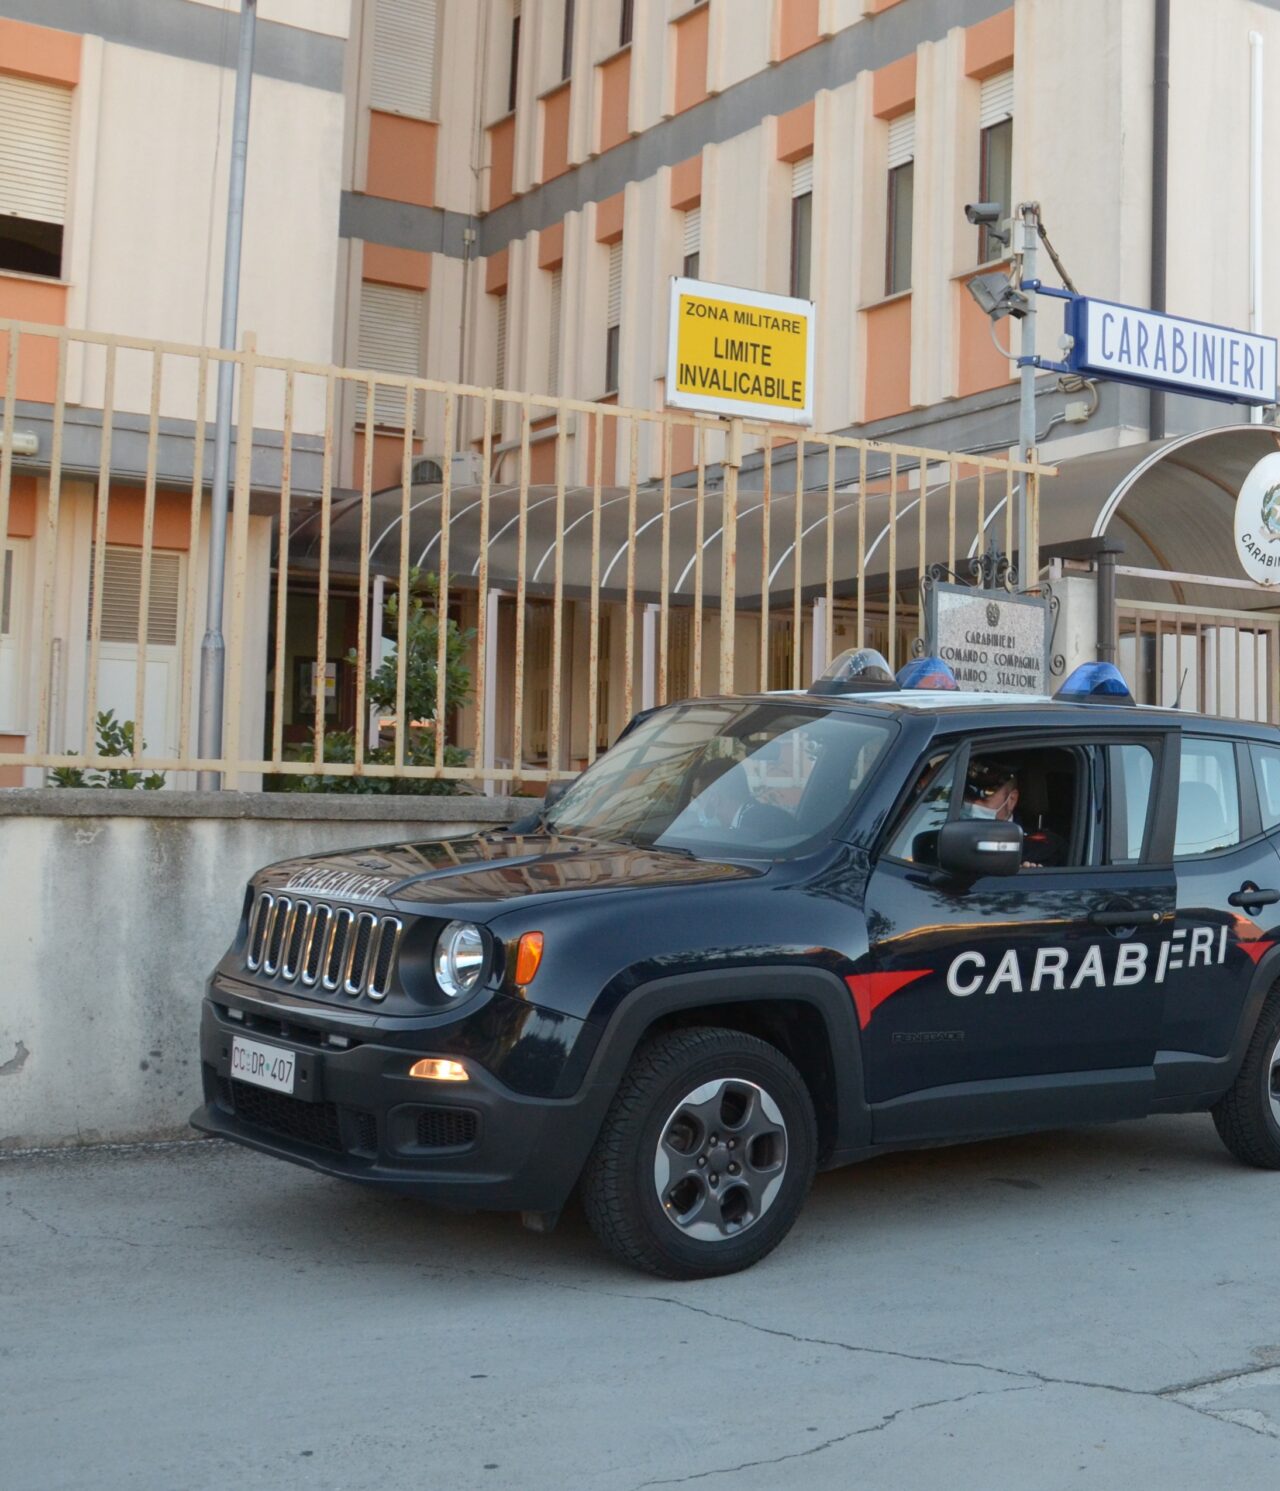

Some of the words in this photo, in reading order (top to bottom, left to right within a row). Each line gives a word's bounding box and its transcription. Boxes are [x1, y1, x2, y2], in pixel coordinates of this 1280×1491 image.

[686, 302, 729, 322] ZONA
[733, 310, 801, 334] MILITARE
[714, 336, 772, 366] LIMITE
[1101, 312, 1265, 391] CARABINIERI
[679, 363, 802, 402] INVALICABILE
[965, 629, 1016, 649] CARABINIERI
[939, 645, 988, 665] COMANDO
[993, 652, 1040, 672] COMPAGNIA
[997, 670, 1037, 690] STAZIONE
[286, 867, 396, 902] CARABINIERI
